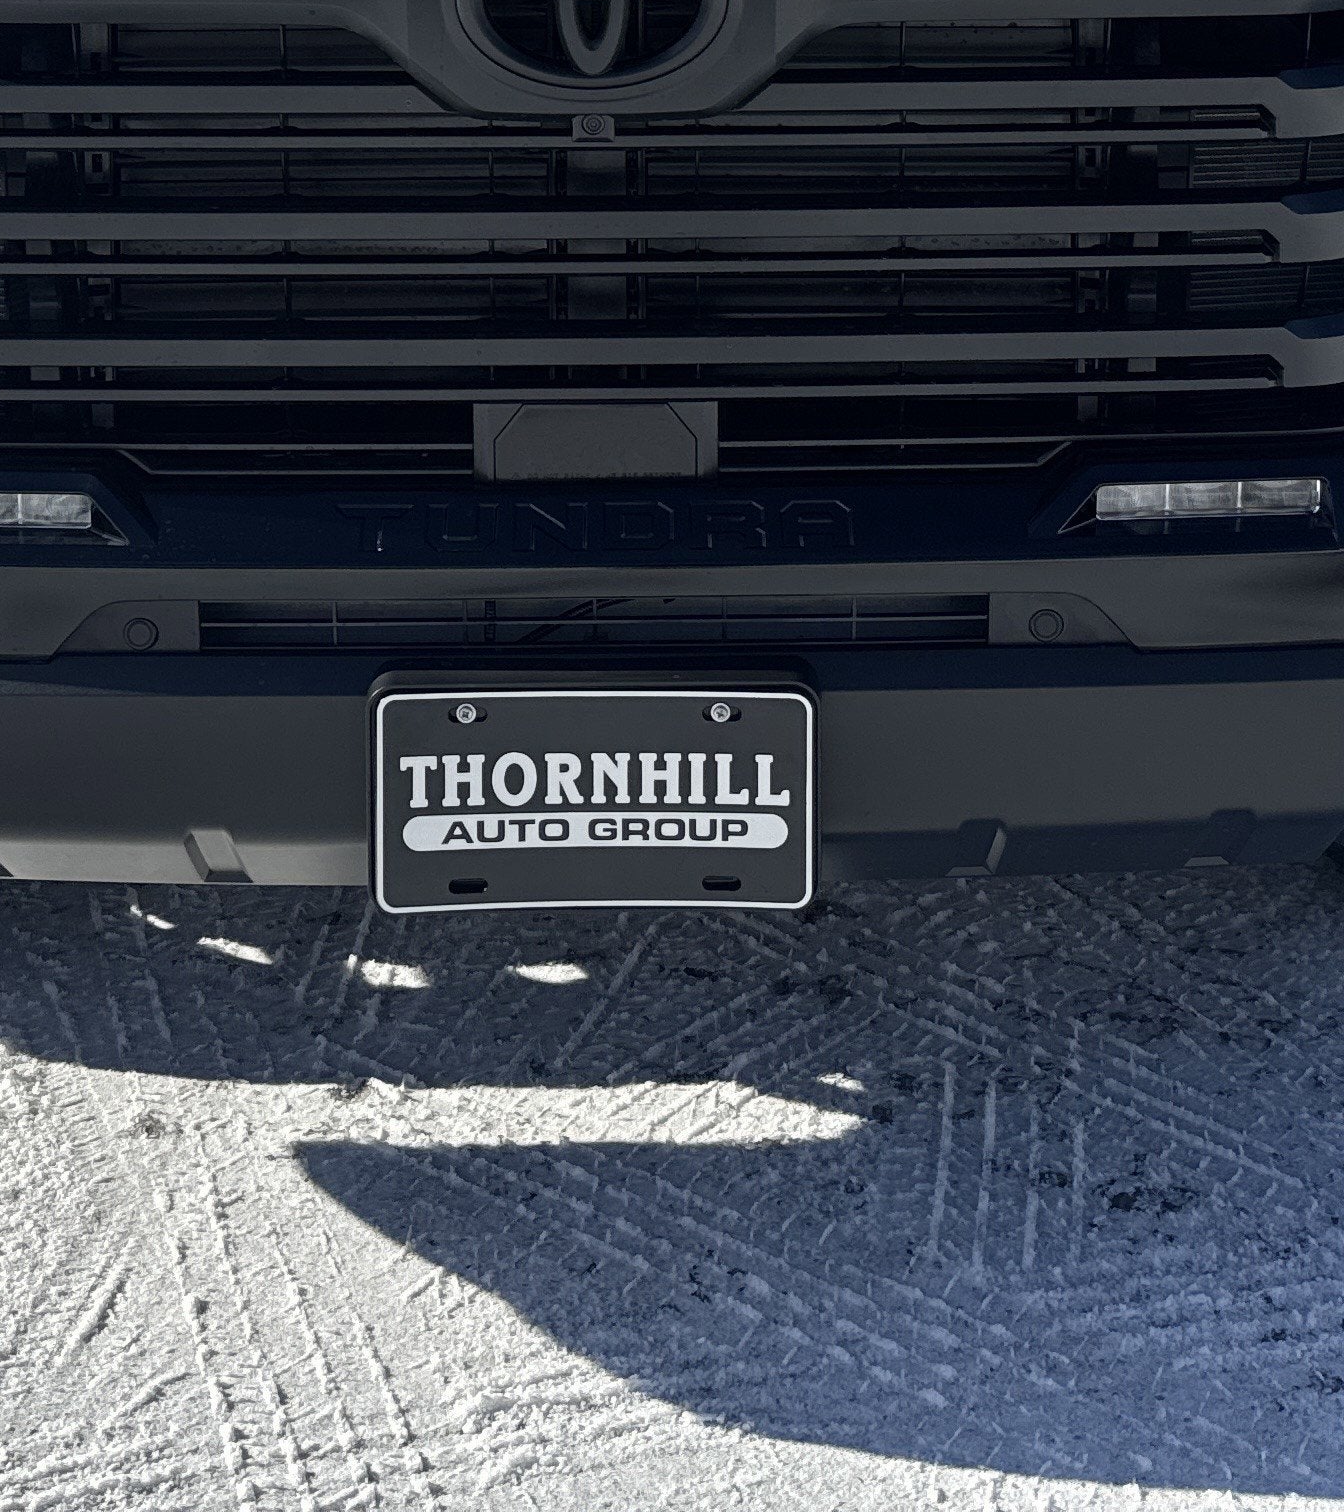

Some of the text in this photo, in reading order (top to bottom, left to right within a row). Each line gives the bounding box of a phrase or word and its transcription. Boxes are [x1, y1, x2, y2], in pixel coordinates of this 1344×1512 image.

[335, 499, 856, 552] TUNDRA
[399, 751, 791, 809] THORNHILL
[441, 817, 749, 845] AUTO GROUP
